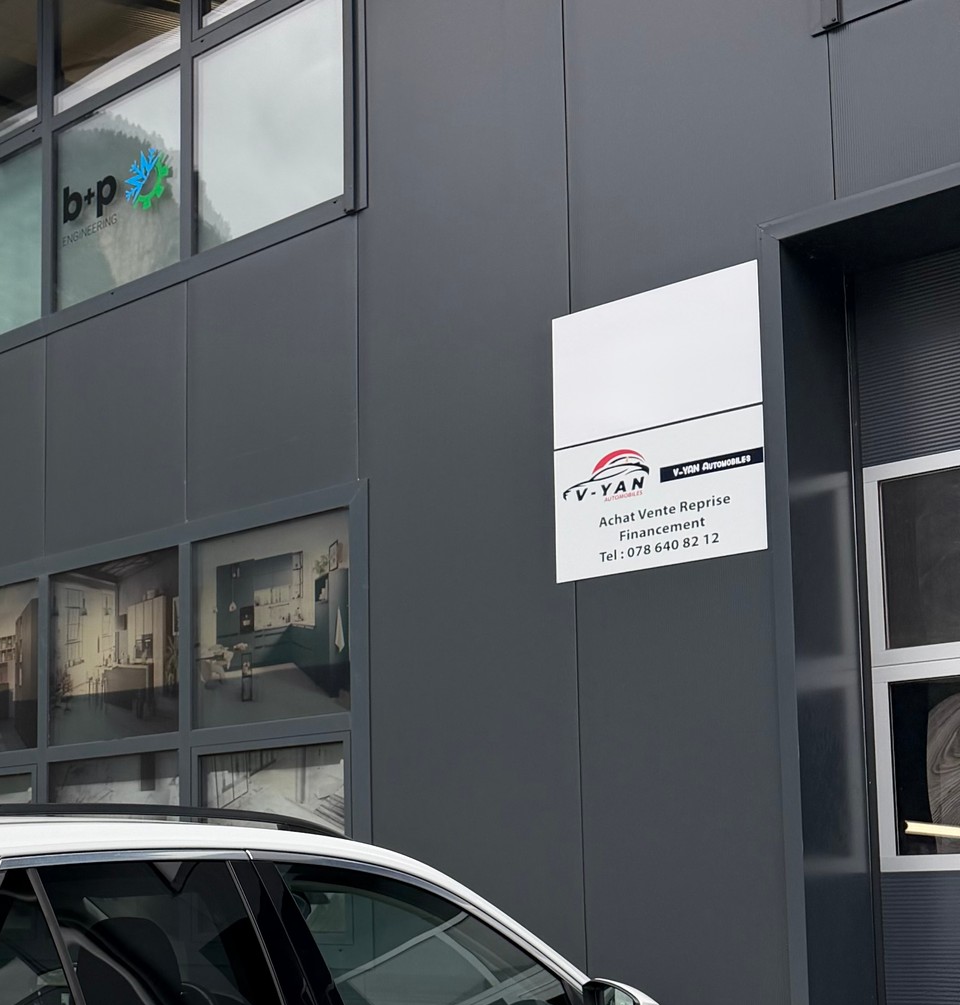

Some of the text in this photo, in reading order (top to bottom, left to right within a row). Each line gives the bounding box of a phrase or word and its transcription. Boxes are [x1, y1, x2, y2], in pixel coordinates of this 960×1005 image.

[63, 175, 117, 224] b+p
[62, 213, 118, 247] ENGINEERING
[673, 464, 700, 477] V-YAN
[576, 476, 644, 501] V-YAN
[604, 490, 643, 502] AUTOMOBILES
[599, 495, 731, 528] Achat Vente Reprise
[620, 517, 705, 541] Financement
[627, 544, 651, 558] 078
[655, 539, 679, 553] 640
[683, 536, 699, 548] 82
[704, 532, 720, 544] 12
